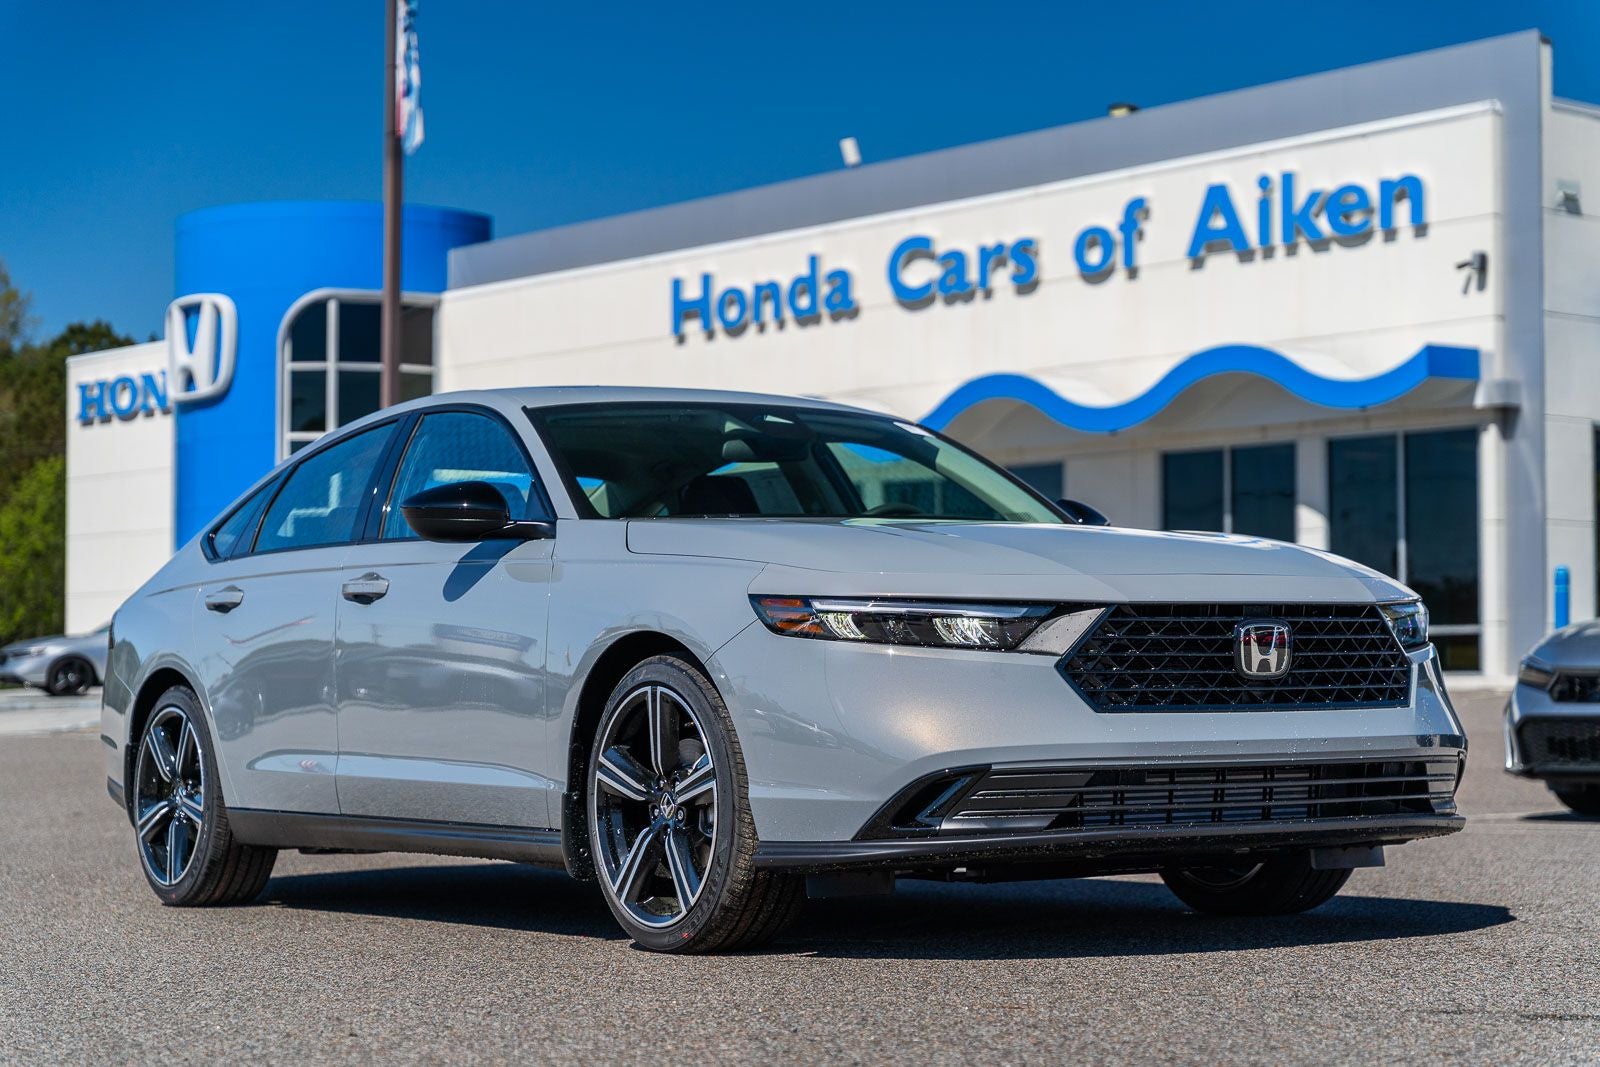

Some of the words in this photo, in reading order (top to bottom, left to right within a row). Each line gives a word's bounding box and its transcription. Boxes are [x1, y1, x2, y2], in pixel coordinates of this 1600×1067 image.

[671, 255, 857, 338] Honda
[886, 236, 1037, 305] Cars
[1072, 196, 1148, 278] of
[1186, 171, 1426, 261] Aiken
